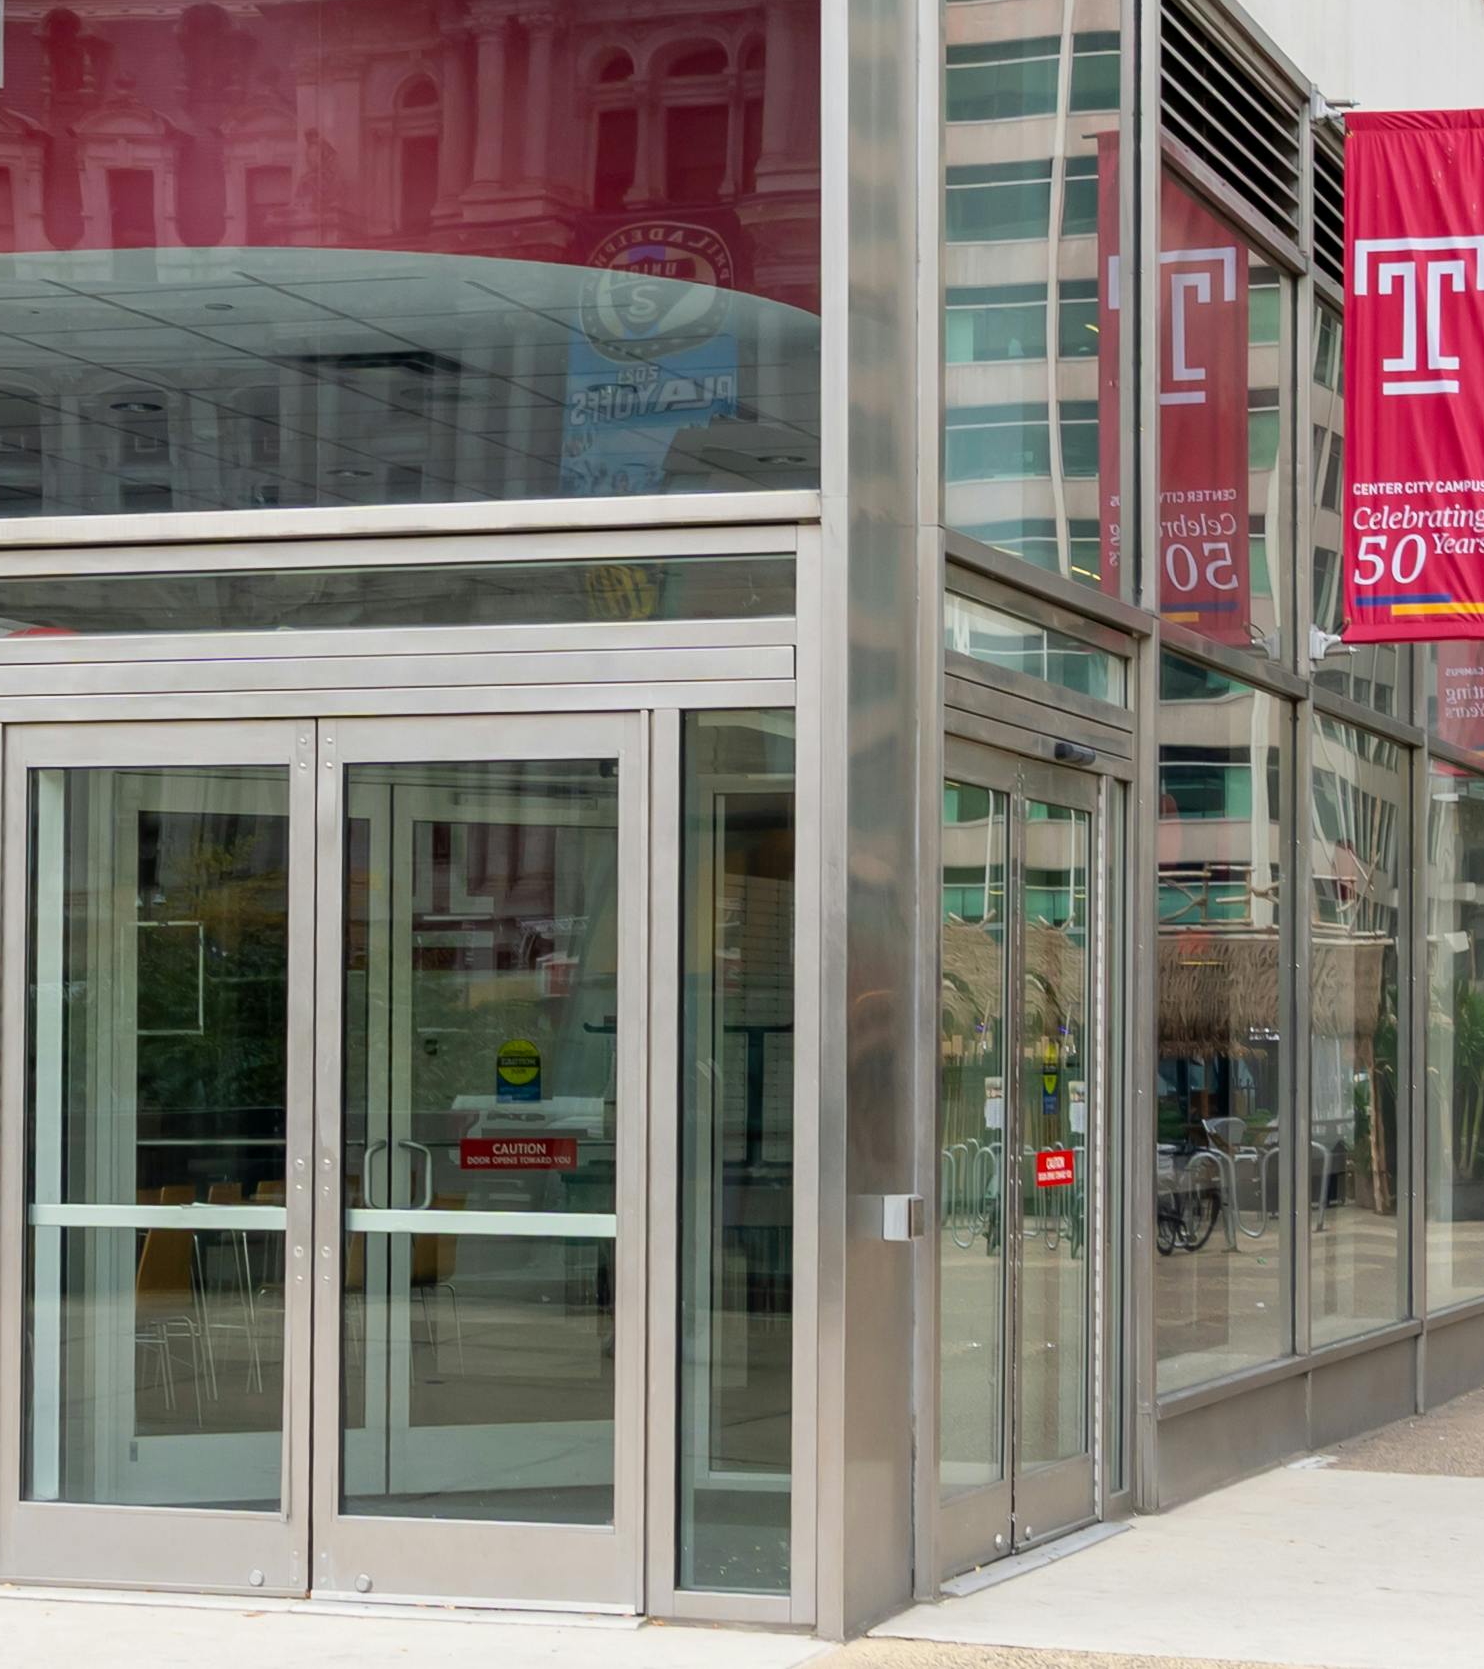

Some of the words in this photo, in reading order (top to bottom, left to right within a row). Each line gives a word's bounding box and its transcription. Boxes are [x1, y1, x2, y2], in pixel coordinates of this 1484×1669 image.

[1352, 482, 1403, 495] CENTER
[1405, 481, 1434, 494] CITY
[1353, 533, 1427, 586] 50
[492, 1143, 547, 1155] CAUTION
[553, 1156, 572, 1165] YOU
